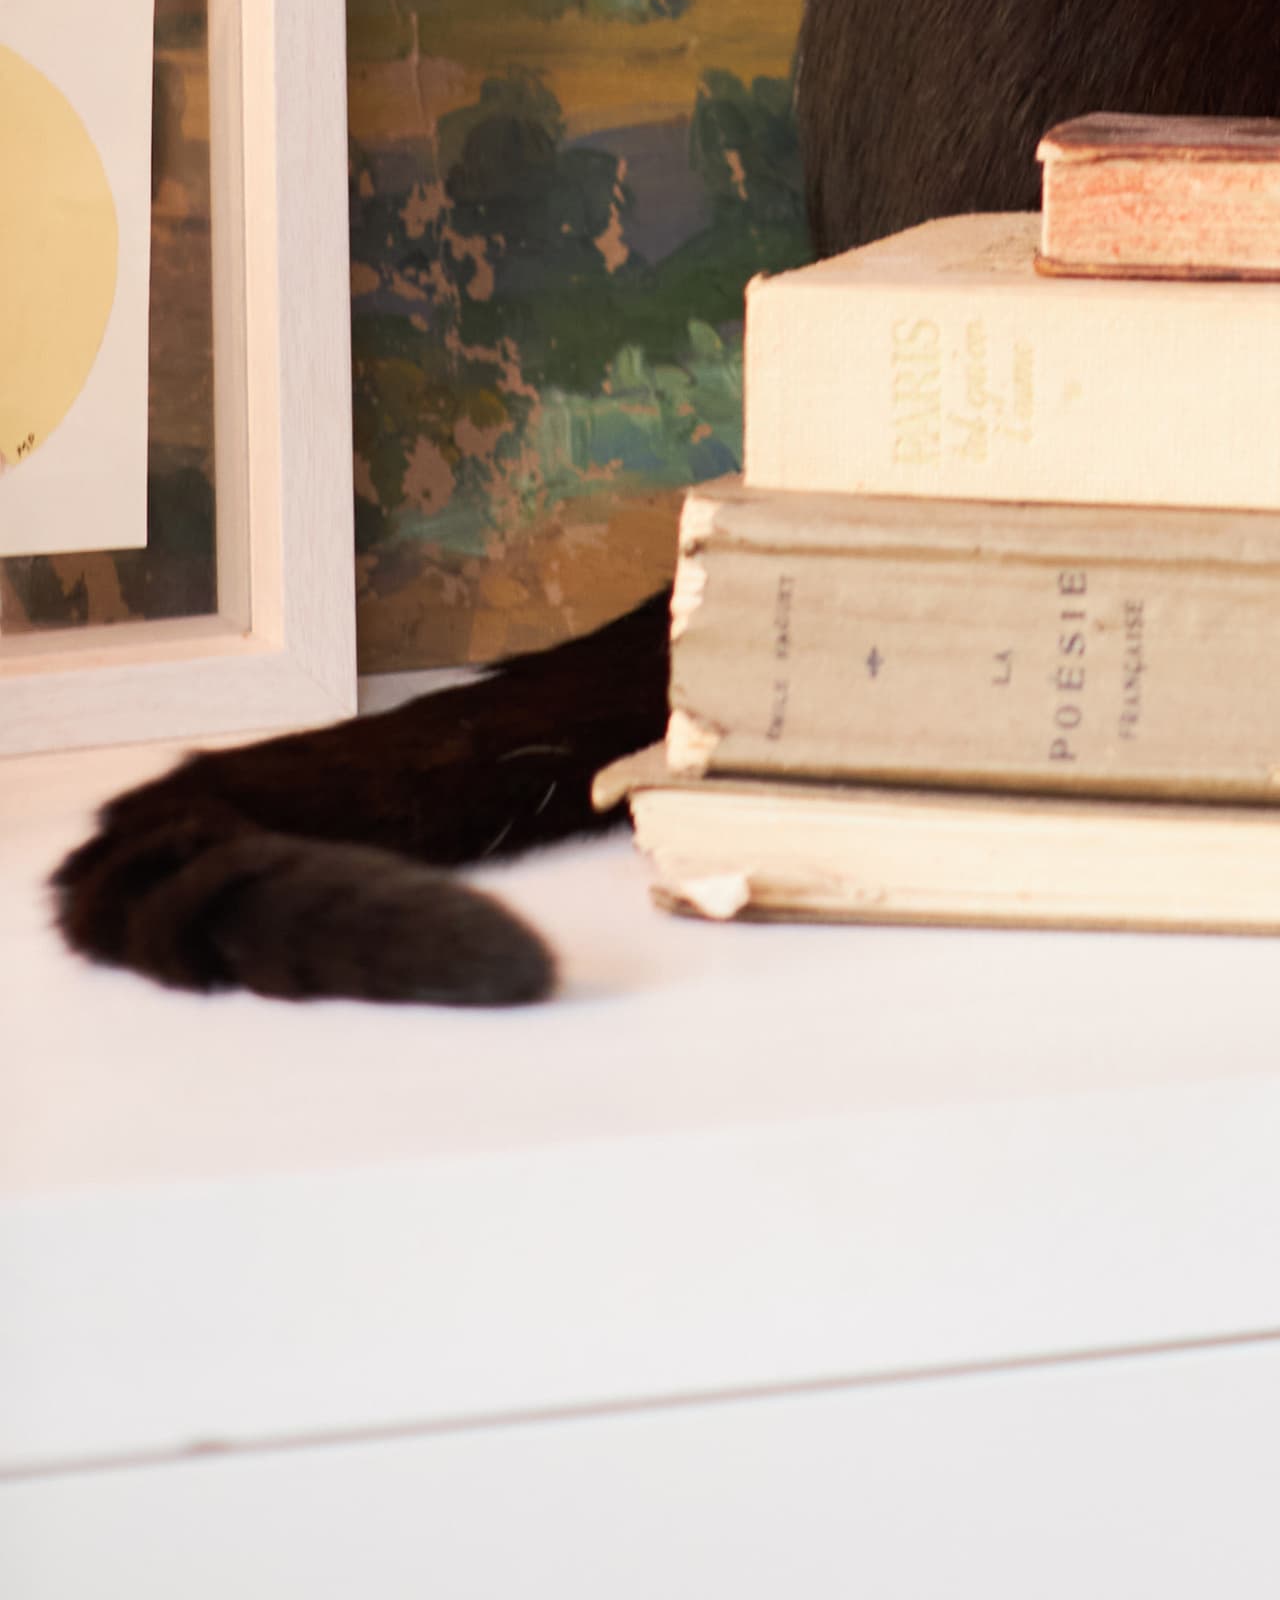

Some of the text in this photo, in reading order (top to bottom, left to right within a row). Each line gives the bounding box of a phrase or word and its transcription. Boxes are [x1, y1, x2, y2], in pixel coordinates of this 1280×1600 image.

[890, 318, 941, 467] PARIS
[991, 648, 1013, 687] LA
[1046, 569, 1088, 763] POÉSIE
[1118, 599, 1147, 741] FRANÇAISE
